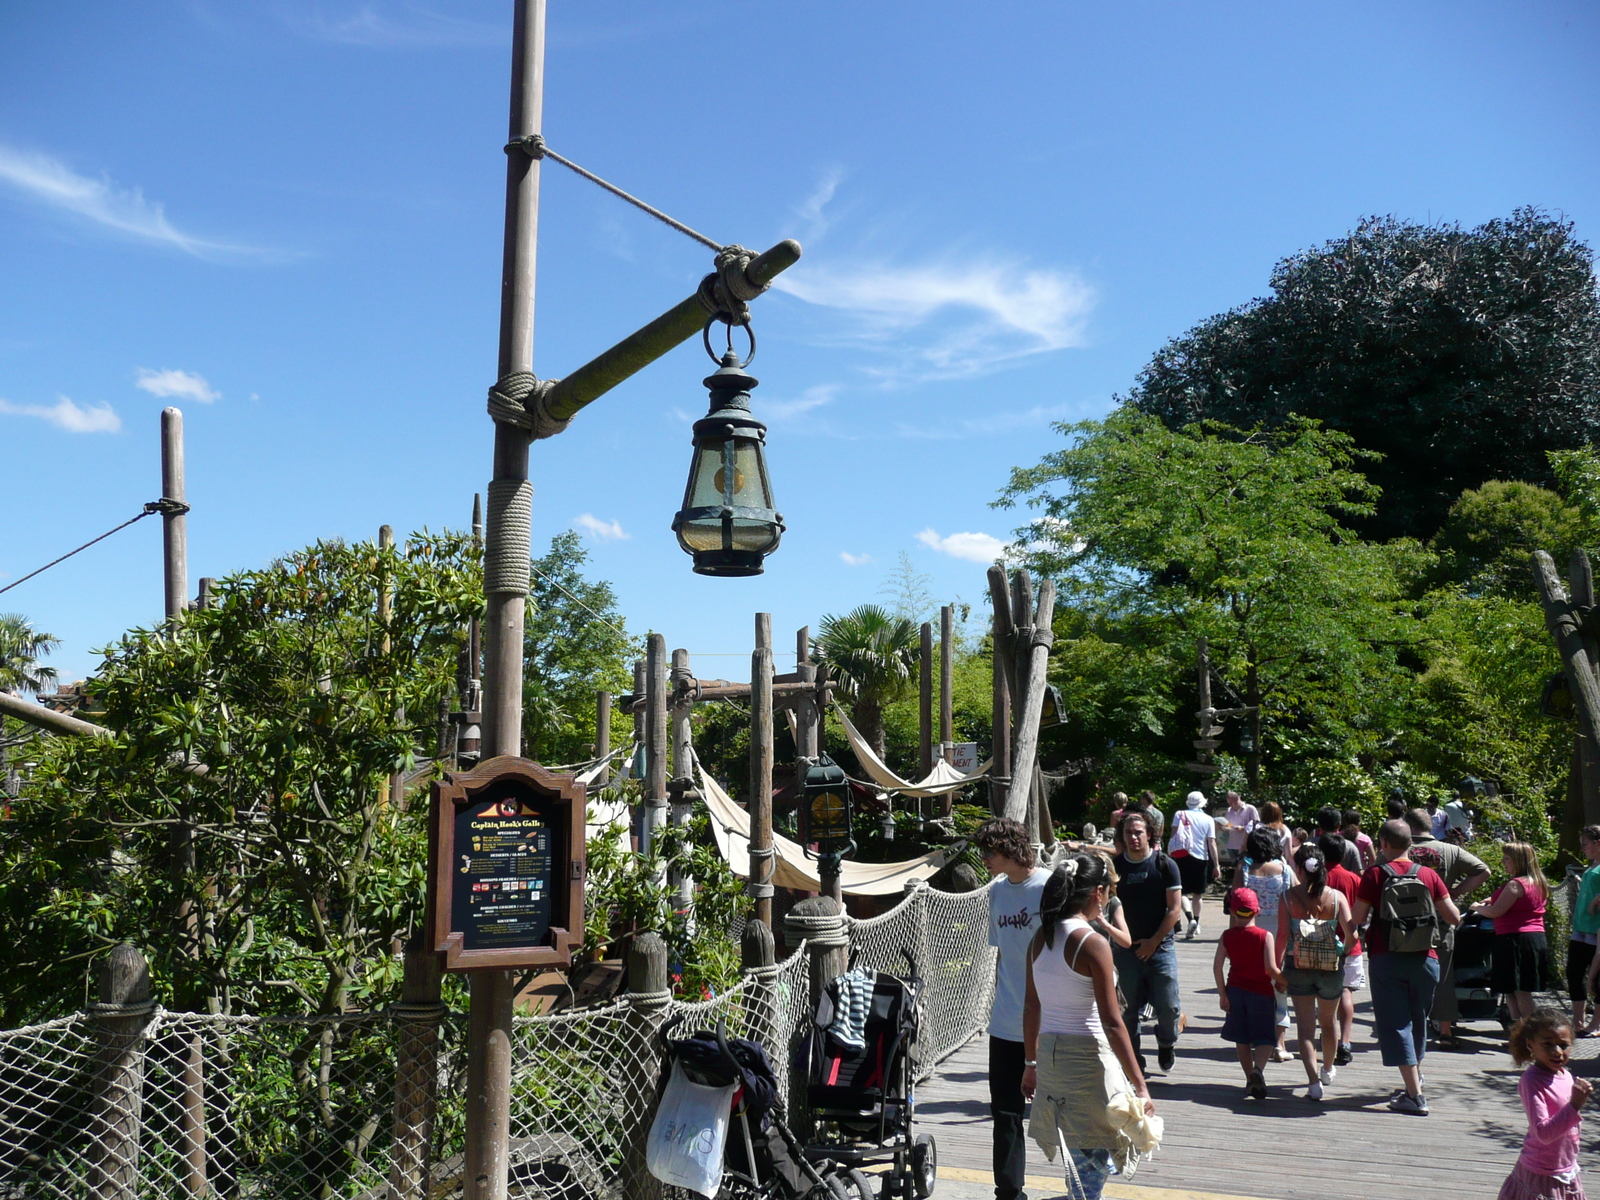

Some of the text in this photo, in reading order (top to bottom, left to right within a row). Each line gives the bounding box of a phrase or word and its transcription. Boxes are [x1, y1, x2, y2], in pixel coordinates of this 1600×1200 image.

[471, 820, 545, 830] Captain Hook's Galley
